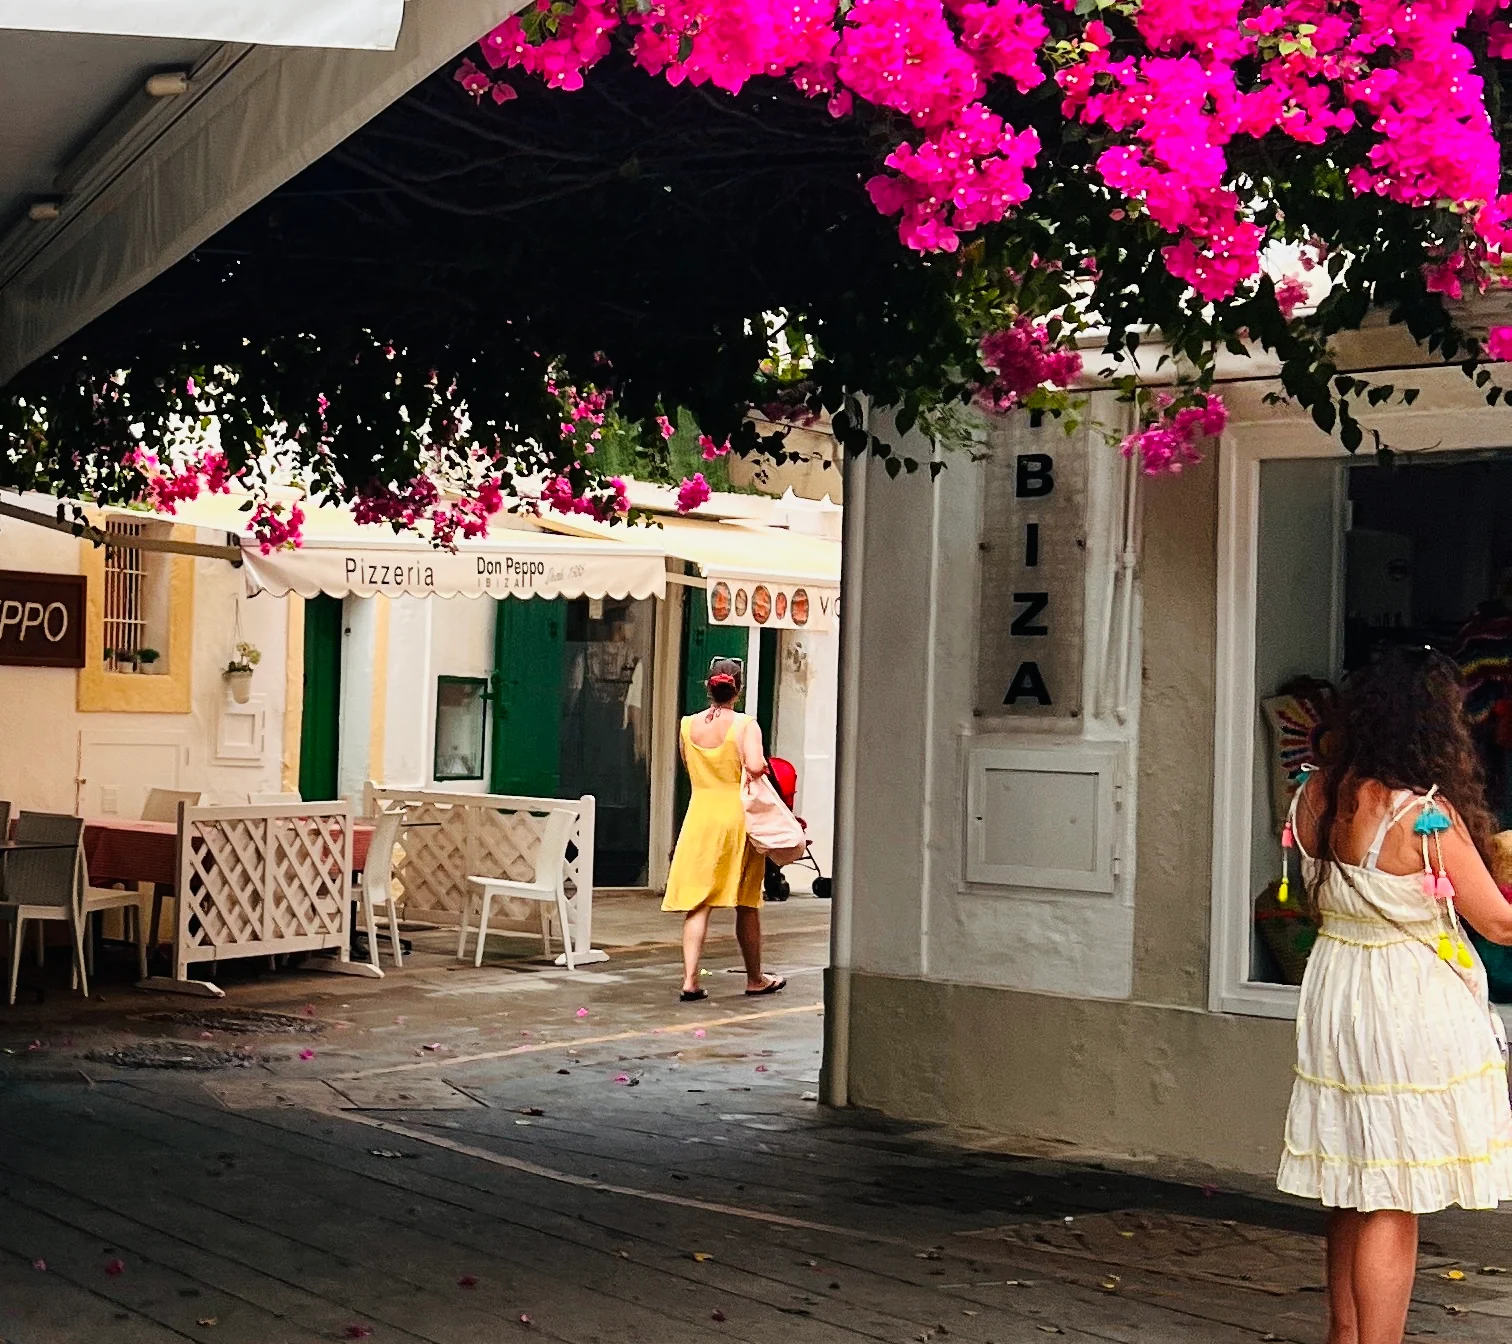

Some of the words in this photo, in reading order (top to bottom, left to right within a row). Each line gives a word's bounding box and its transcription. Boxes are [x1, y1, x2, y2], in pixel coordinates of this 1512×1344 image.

[345, 557, 435, 587] Pizzeria
[476, 556, 502, 575] Don
[505, 557, 545, 588] Peppo
[477, 577, 520, 588] IBIZA
